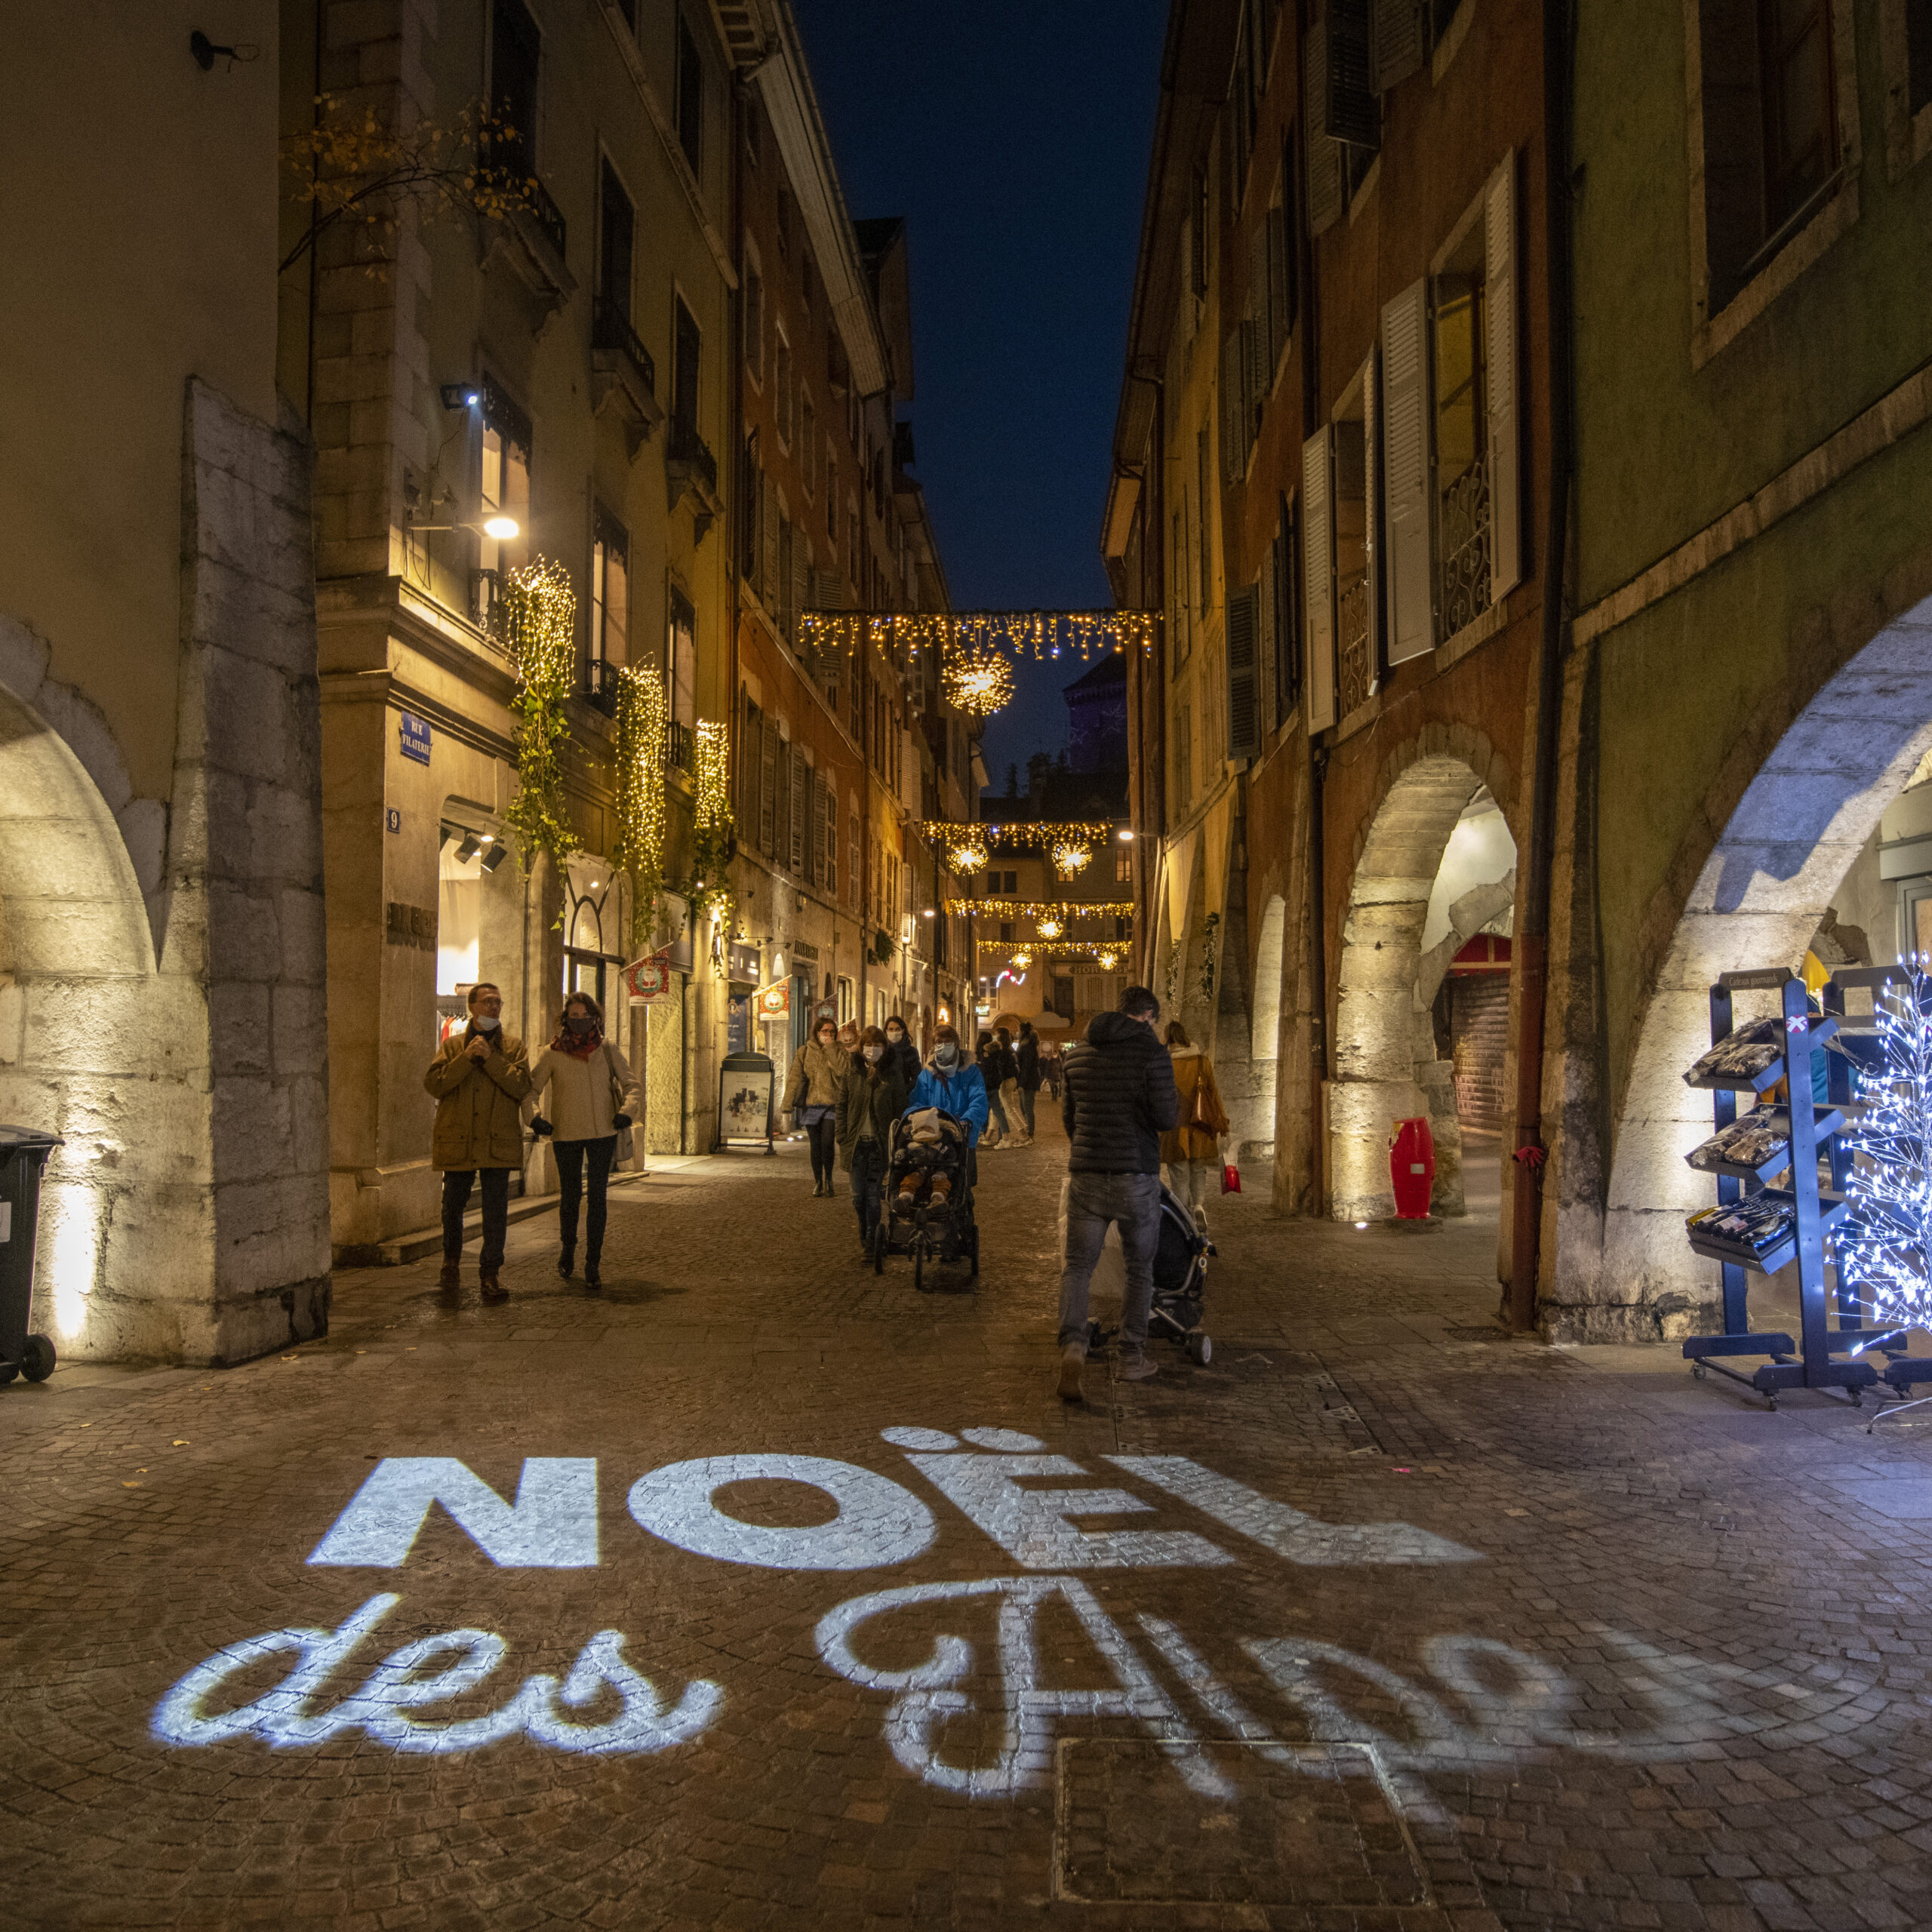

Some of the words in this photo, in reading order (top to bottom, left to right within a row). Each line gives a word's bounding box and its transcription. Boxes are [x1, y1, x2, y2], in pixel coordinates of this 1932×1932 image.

[411, 721, 423, 736] RUE
[403, 734, 429, 755] FILATERIE
[391, 811, 398, 829] 9
[1729, 977, 1750, 986] Cadeaux
[1751, 973, 1778, 987] gourmands
[306, 1426, 1488, 1568] NOËL
[152, 1592, 723, 1754] des
[814, 1575, 1872, 1827] Alpes
